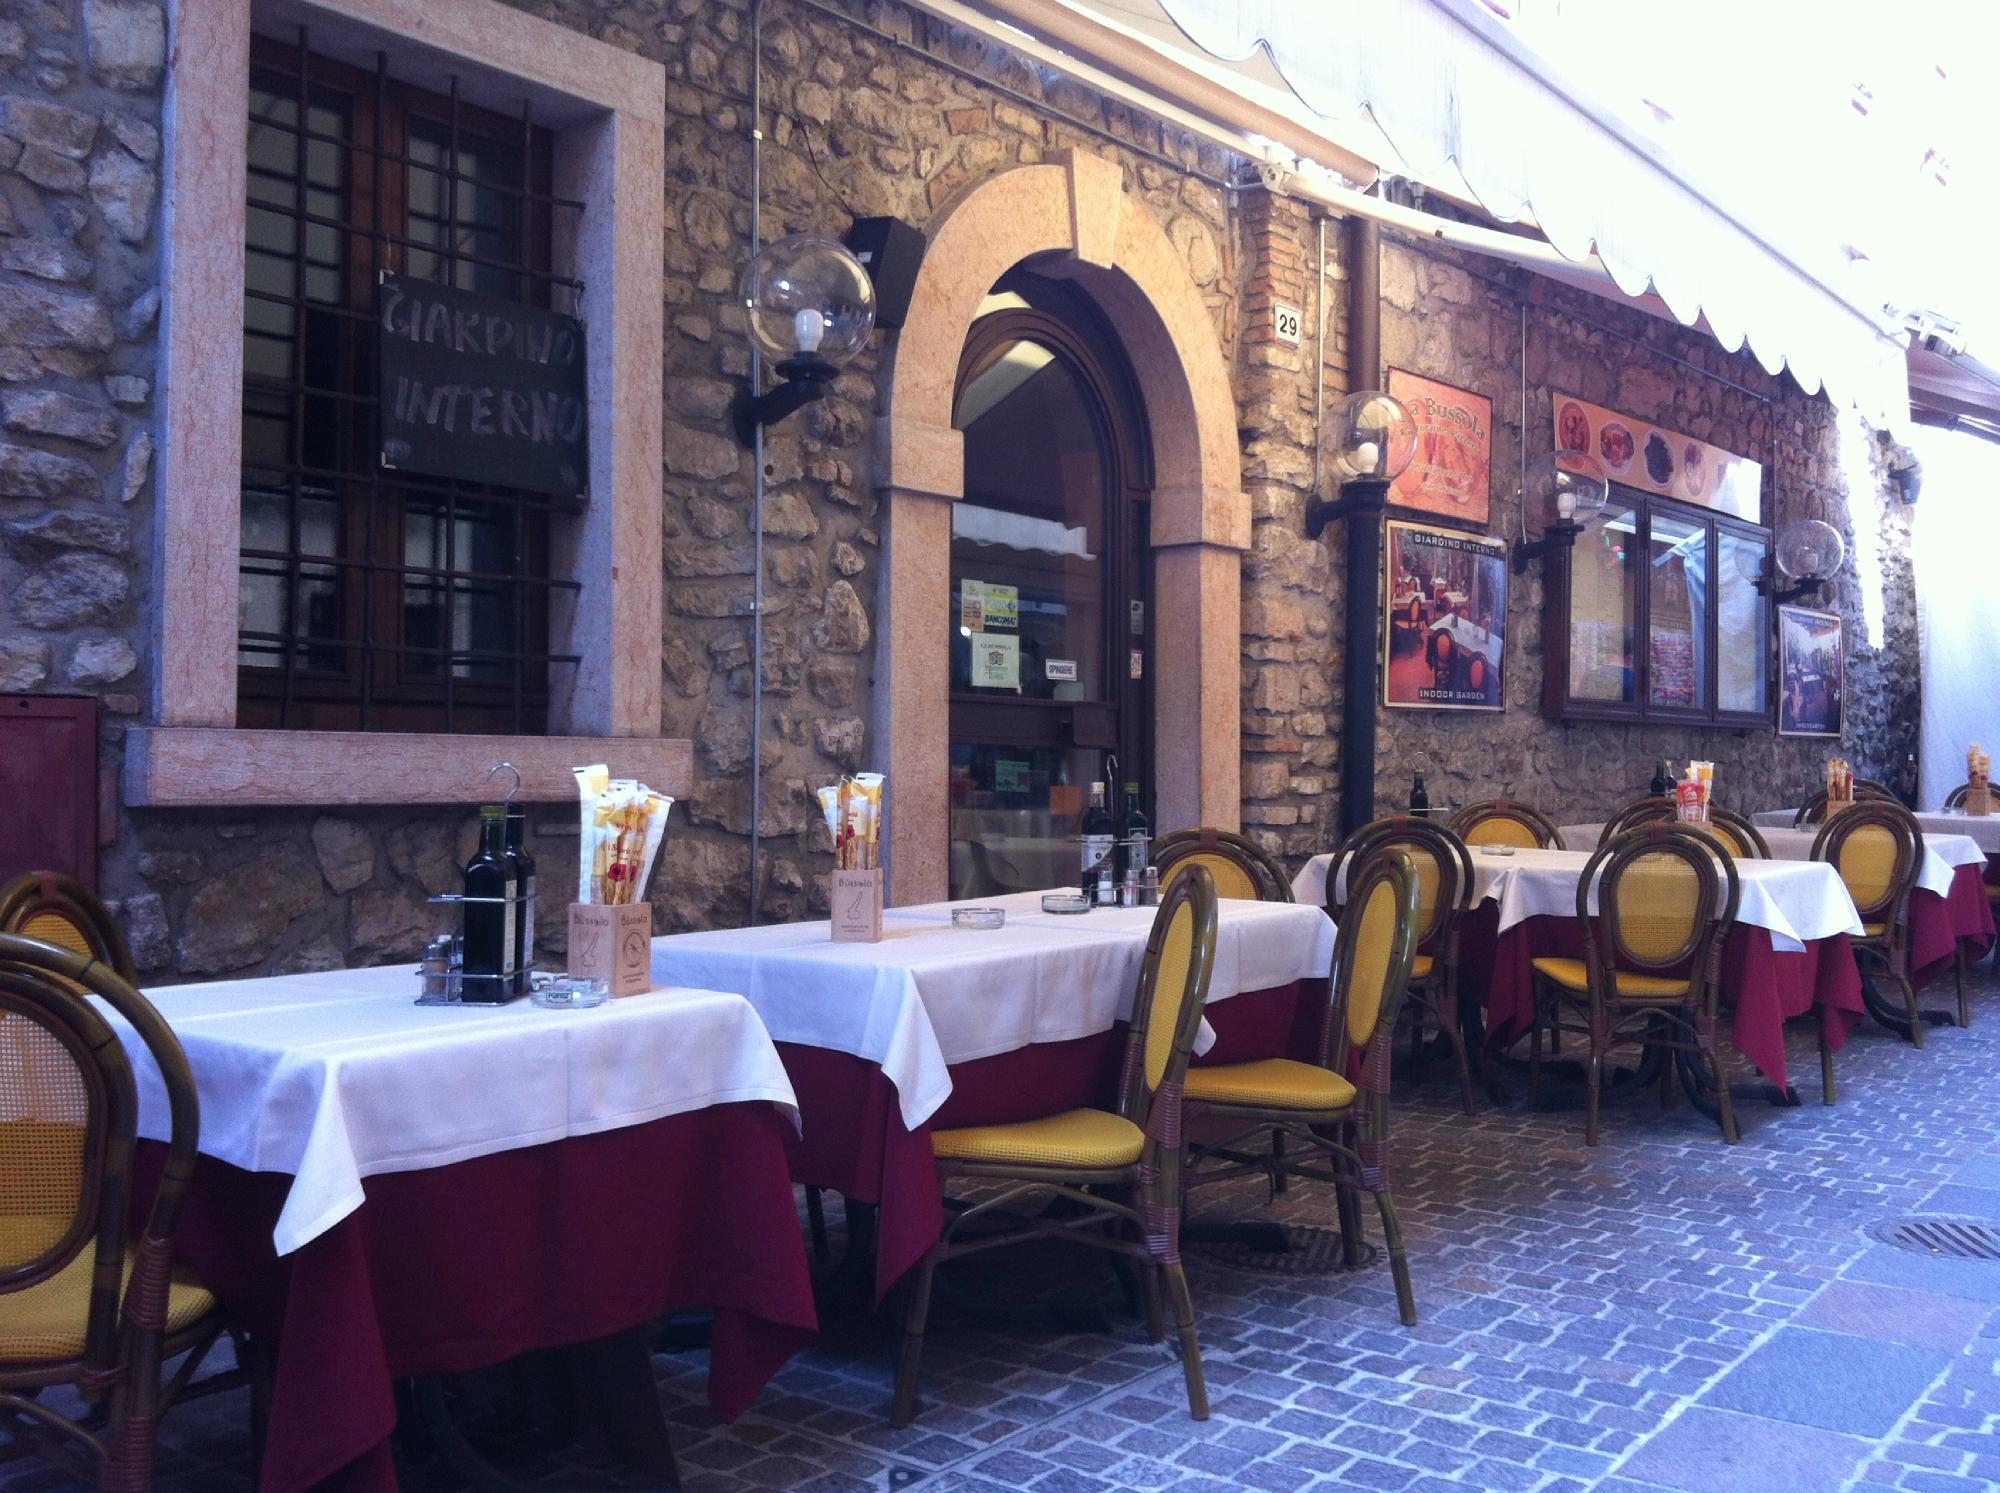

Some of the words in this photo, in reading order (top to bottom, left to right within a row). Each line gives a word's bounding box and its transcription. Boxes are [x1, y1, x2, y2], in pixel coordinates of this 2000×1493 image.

[383, 292, 574, 364] GIARDINO
[1280, 314, 1297, 336] 29
[394, 376, 582, 442] INTERNO
[1425, 398, 1485, 440] Bussola
[1415, 534, 1460, 549] GIARDINO
[1463, 543, 1495, 556] INTERNO
[985, 614, 1017, 625] BANCOMAT
[1420, 690, 1453, 699] INDOOR
[1456, 691, 1485, 700] GARDEN
